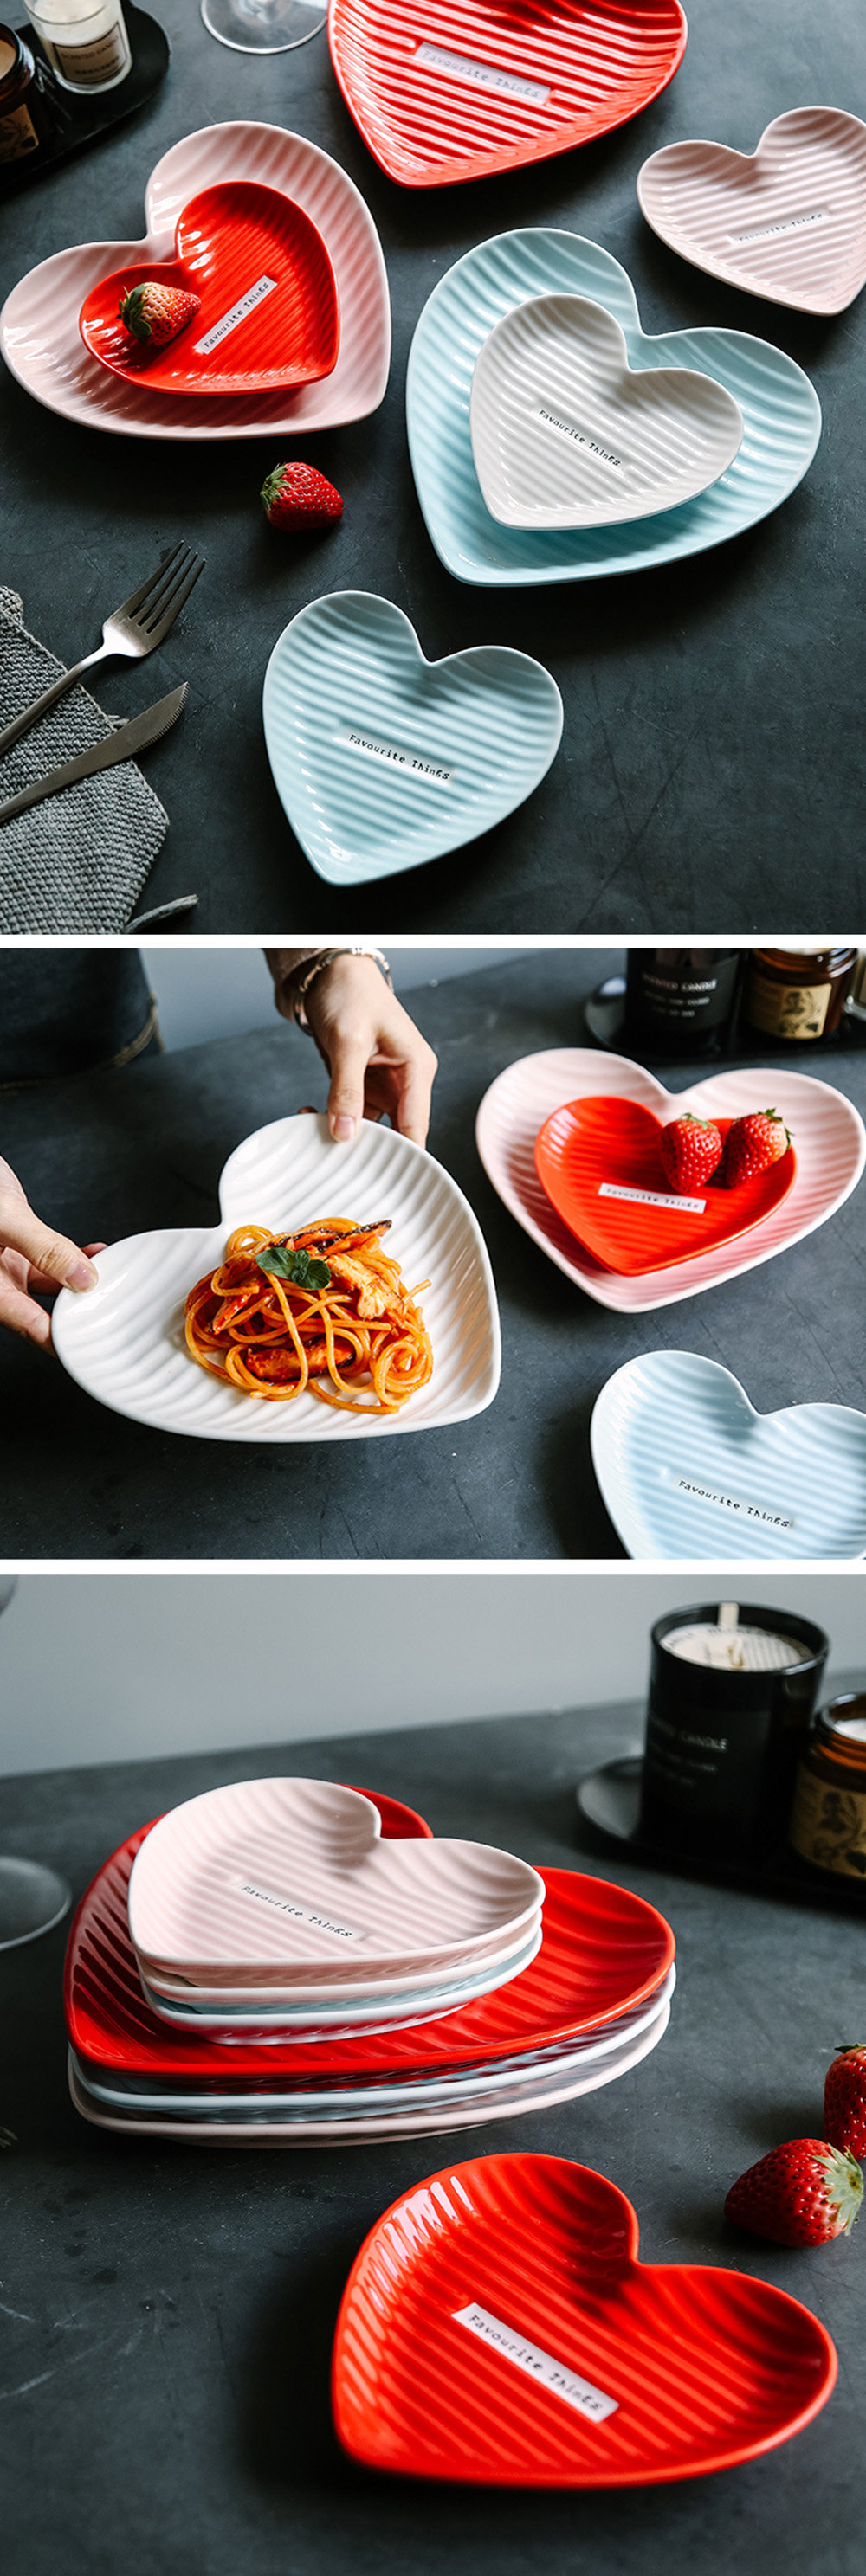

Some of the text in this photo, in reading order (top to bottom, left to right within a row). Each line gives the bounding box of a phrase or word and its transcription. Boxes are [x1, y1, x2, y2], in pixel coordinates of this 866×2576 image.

[421, 49, 489, 81] Favourite
[204, 310, 243, 348] Favourite
[538, 409, 585, 443] Favourite
[348, 734, 405, 763] Favourite
[678, 1480, 740, 1510] Favourite
[241, 1885, 303, 1916] Favourite
[469, 2314, 544, 2370] Favourite
